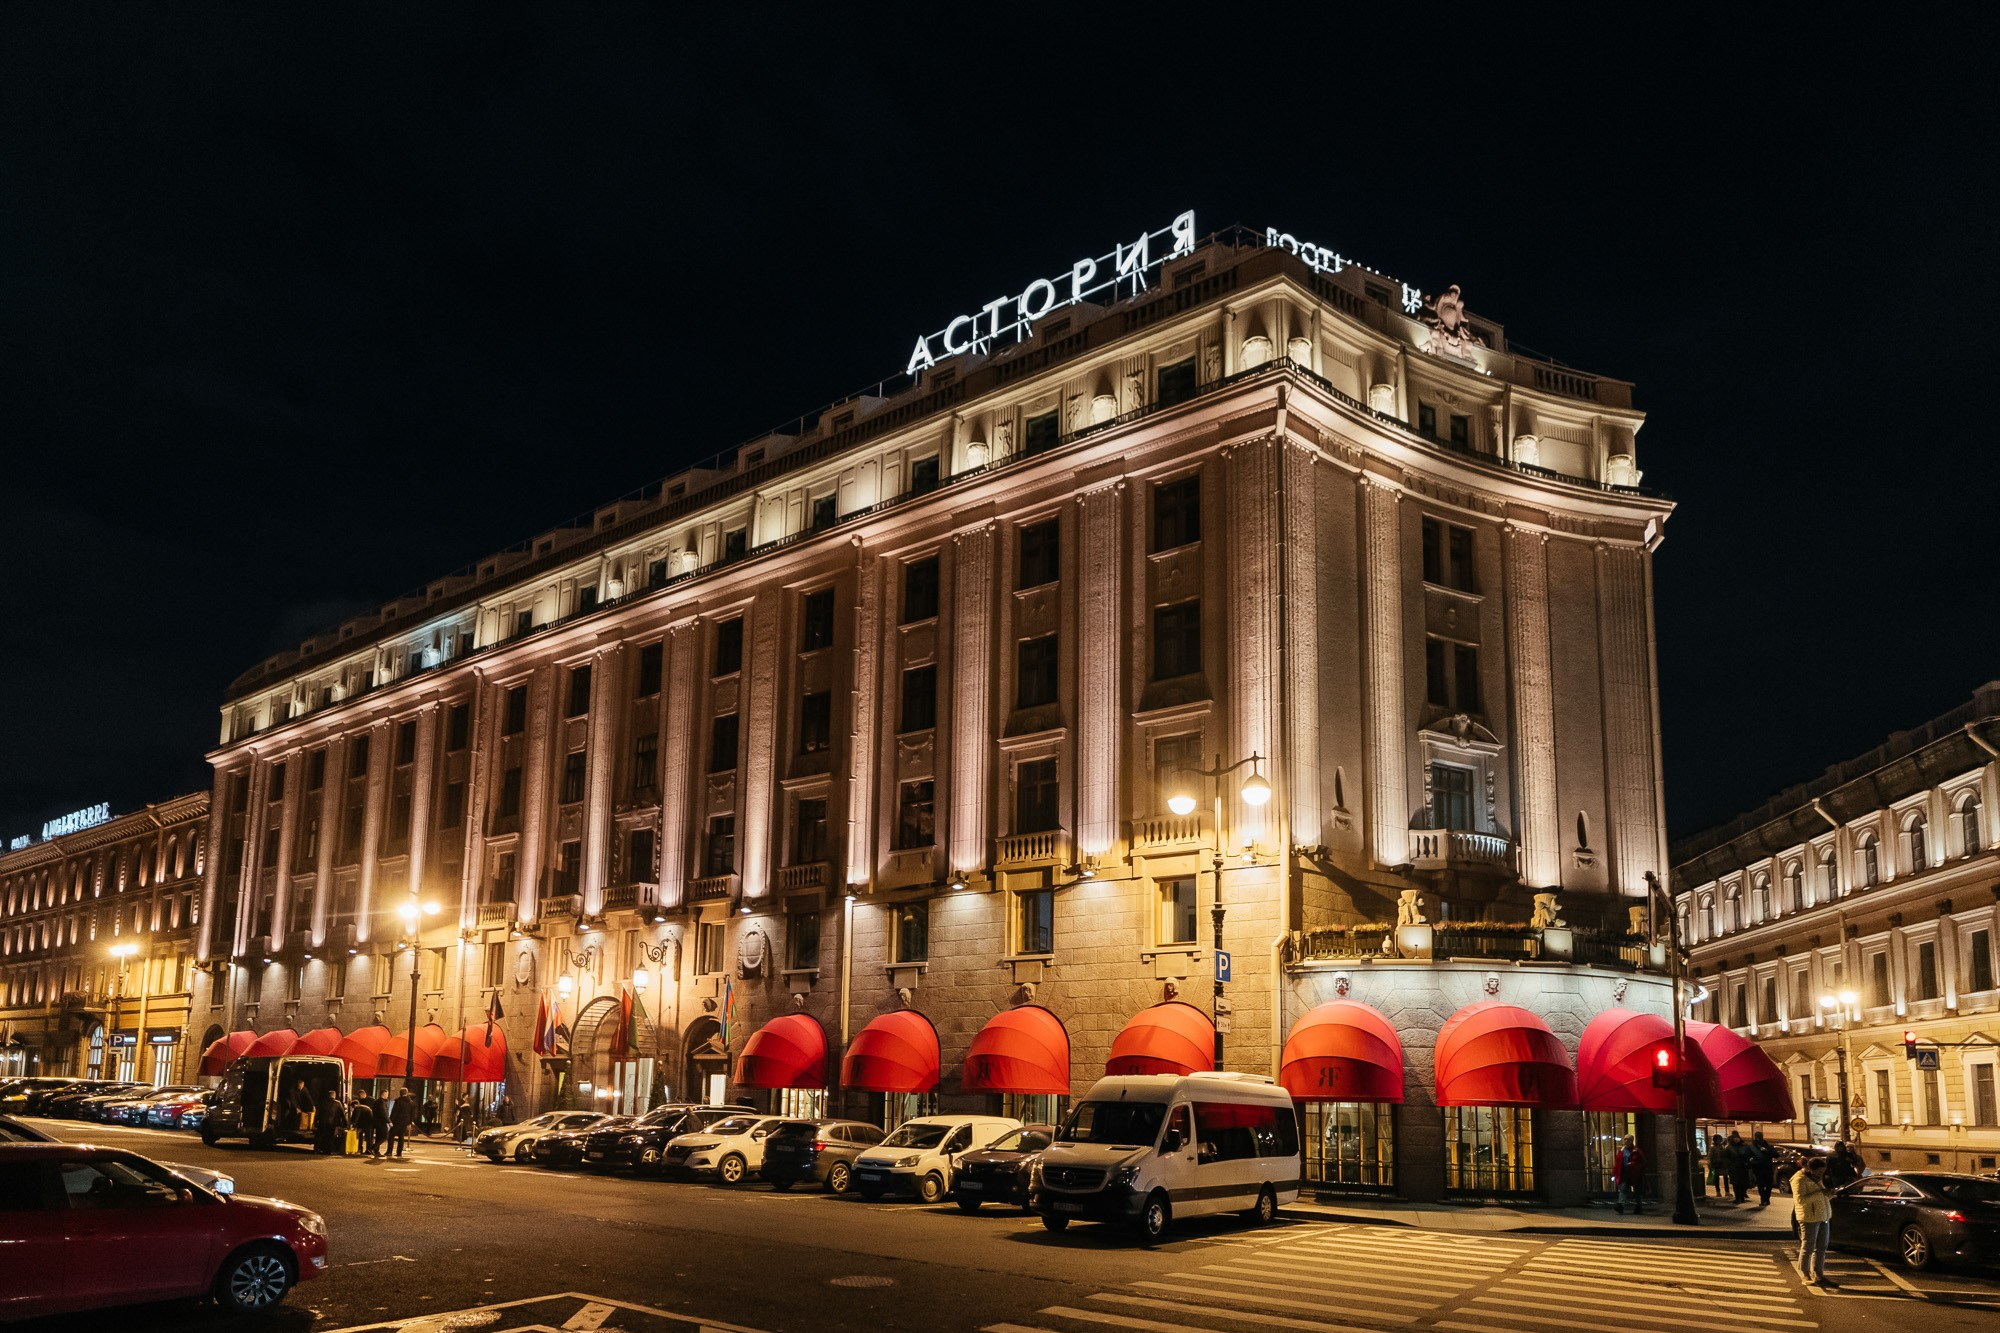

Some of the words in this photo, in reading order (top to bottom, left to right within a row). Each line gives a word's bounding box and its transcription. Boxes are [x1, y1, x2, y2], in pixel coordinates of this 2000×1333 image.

[906, 209, 1196, 374] АСТОРИЯ
[1219, 954, 1229, 979] P
[113, 1036, 123, 1047] P
